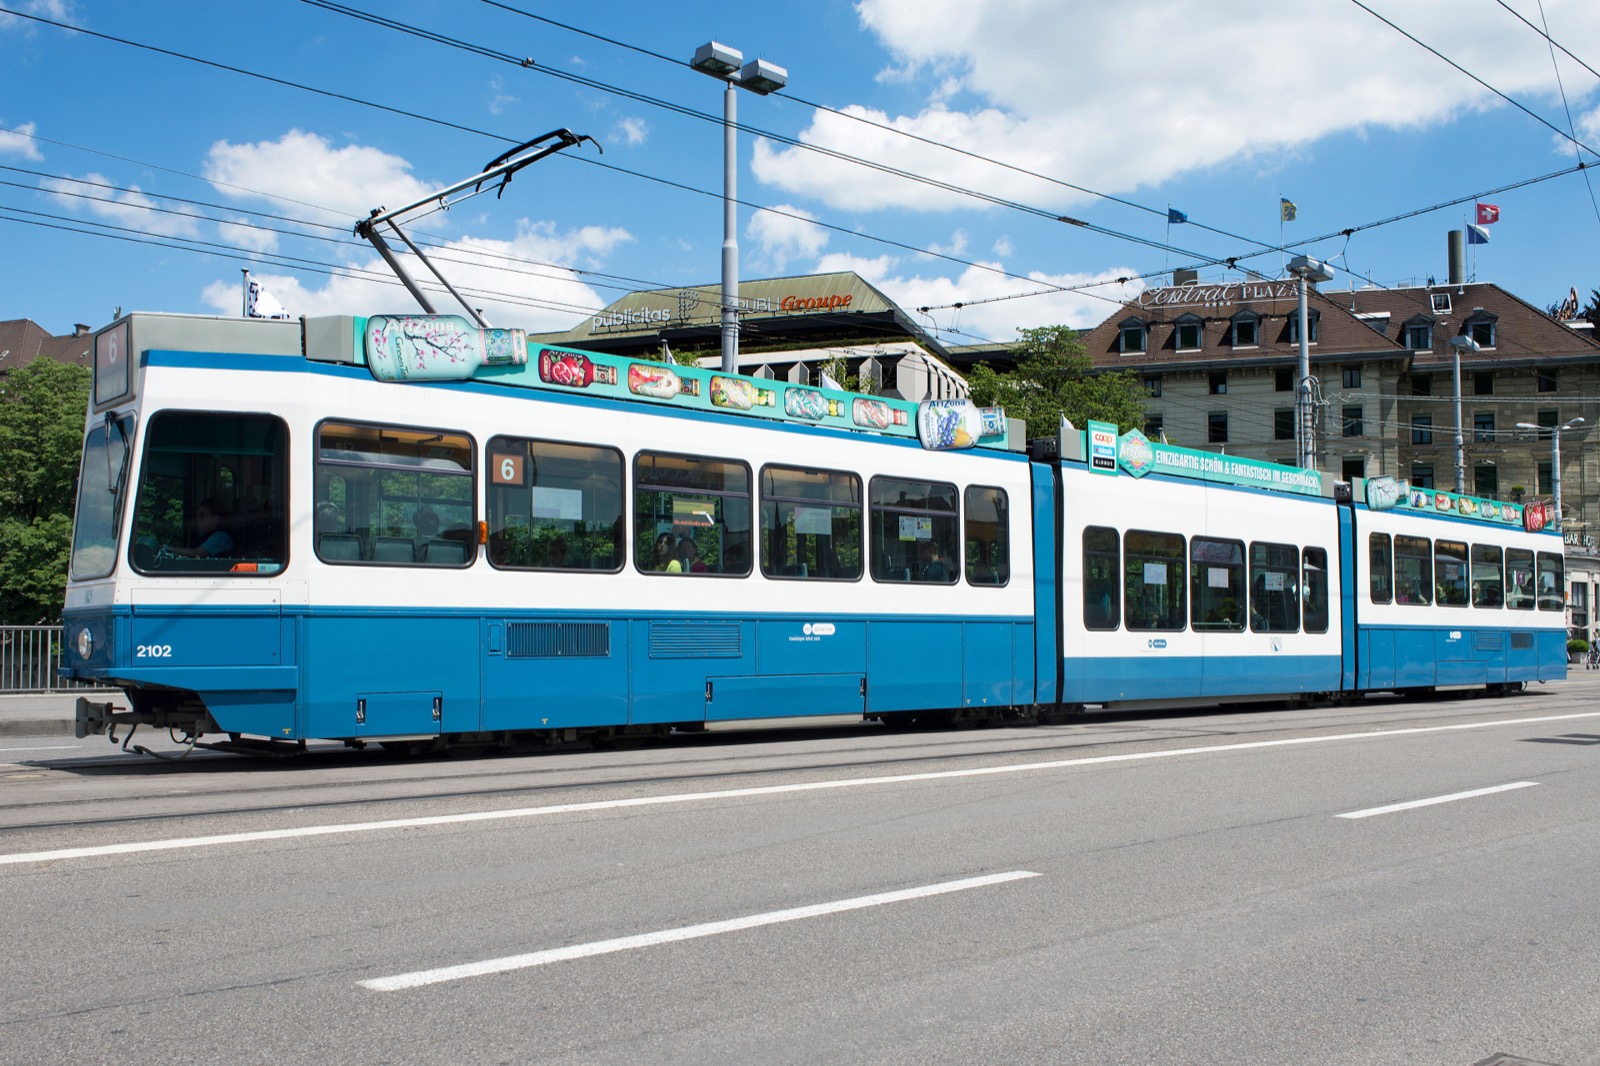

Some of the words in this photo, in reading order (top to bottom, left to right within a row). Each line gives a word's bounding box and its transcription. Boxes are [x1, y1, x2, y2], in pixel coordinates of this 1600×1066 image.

[1138, 278, 1240, 306] Central
[1242, 283, 1299, 299] PLAZA
[591, 308, 671, 332] publicitas
[109, 332, 117, 364] 6
[1095, 433, 1113, 444] coop
[501, 458, 515, 480] 6
[1155, 450, 1199, 470] EINZIGARTIG
[1200, 456, 1223, 473] SCHÖN
[1225, 464, 1230, 475] &
[1231, 465, 1272, 481] FANTASTISCH
[1272, 471, 1281, 483] IM
[1564, 533, 1579, 545] BAR
[137, 645, 172, 657] 2102
